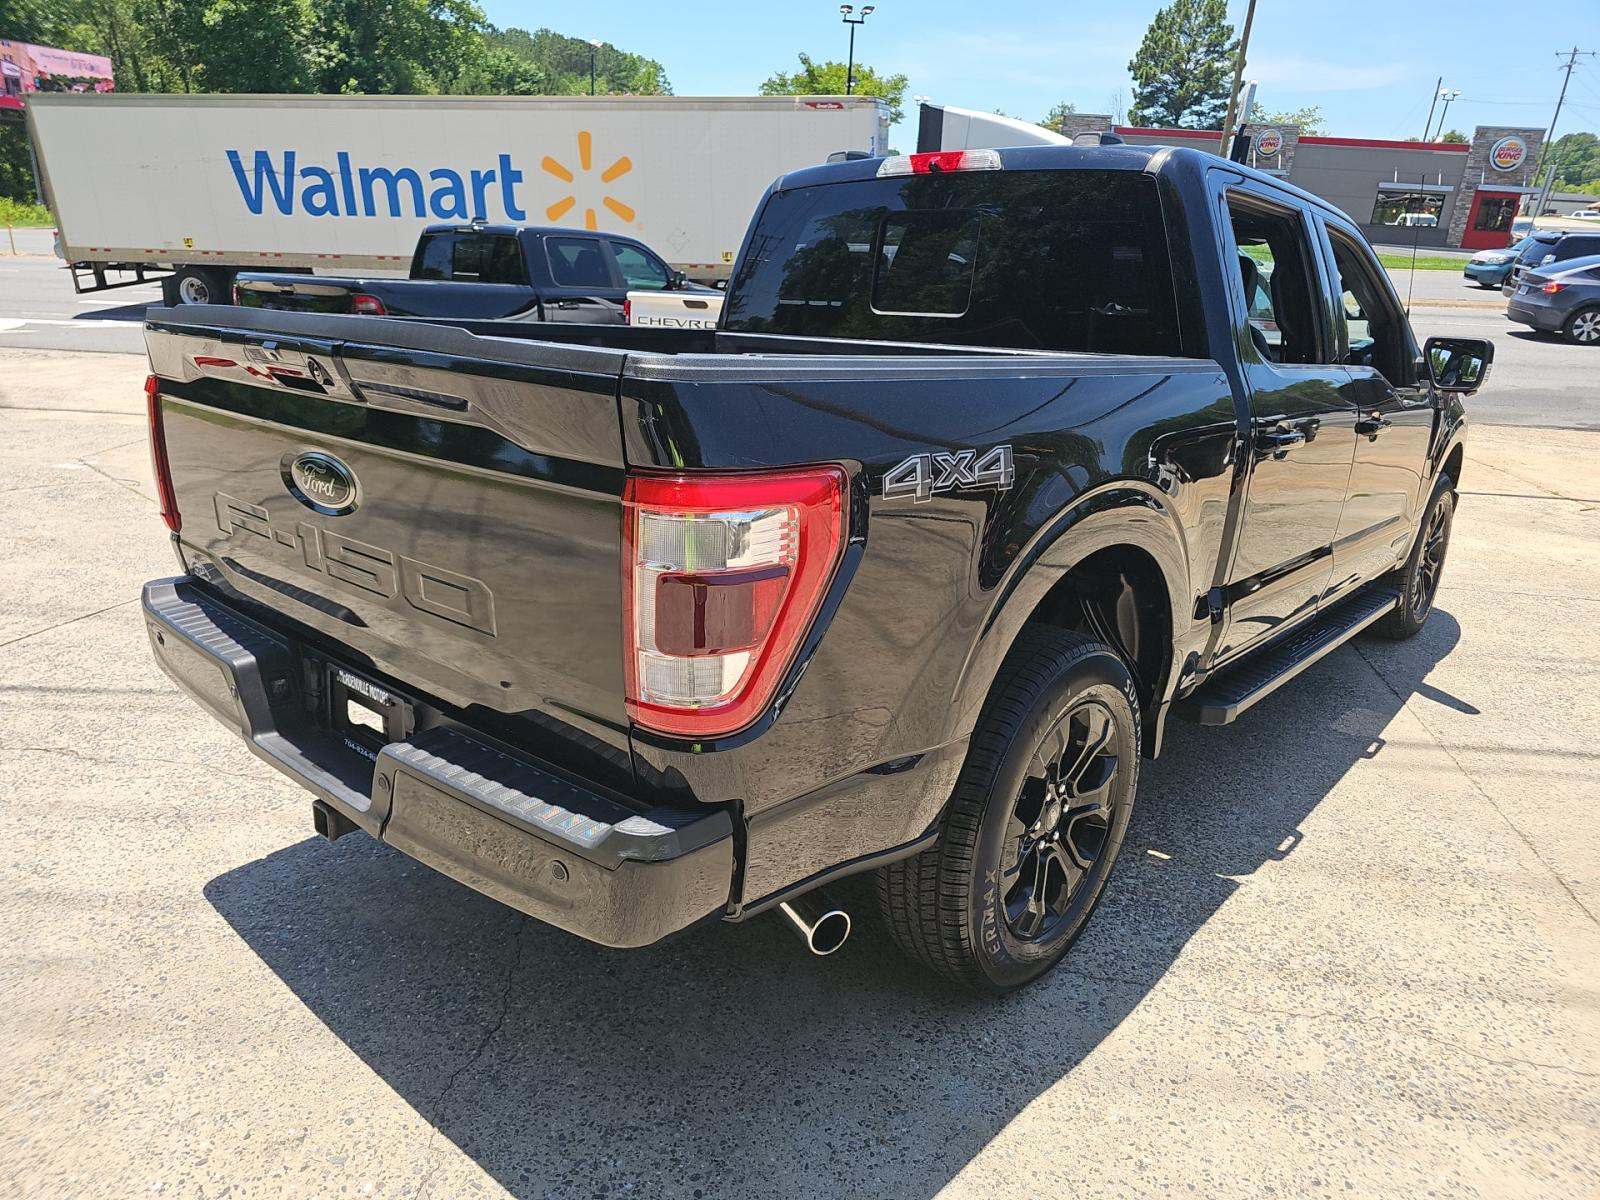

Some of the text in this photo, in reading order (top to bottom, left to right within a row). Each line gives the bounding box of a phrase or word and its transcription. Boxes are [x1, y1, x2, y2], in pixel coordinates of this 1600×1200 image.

[1495, 150, 1522, 161] KING
[225, 149, 527, 221] Walmart
[302, 463, 337, 497] Ford
